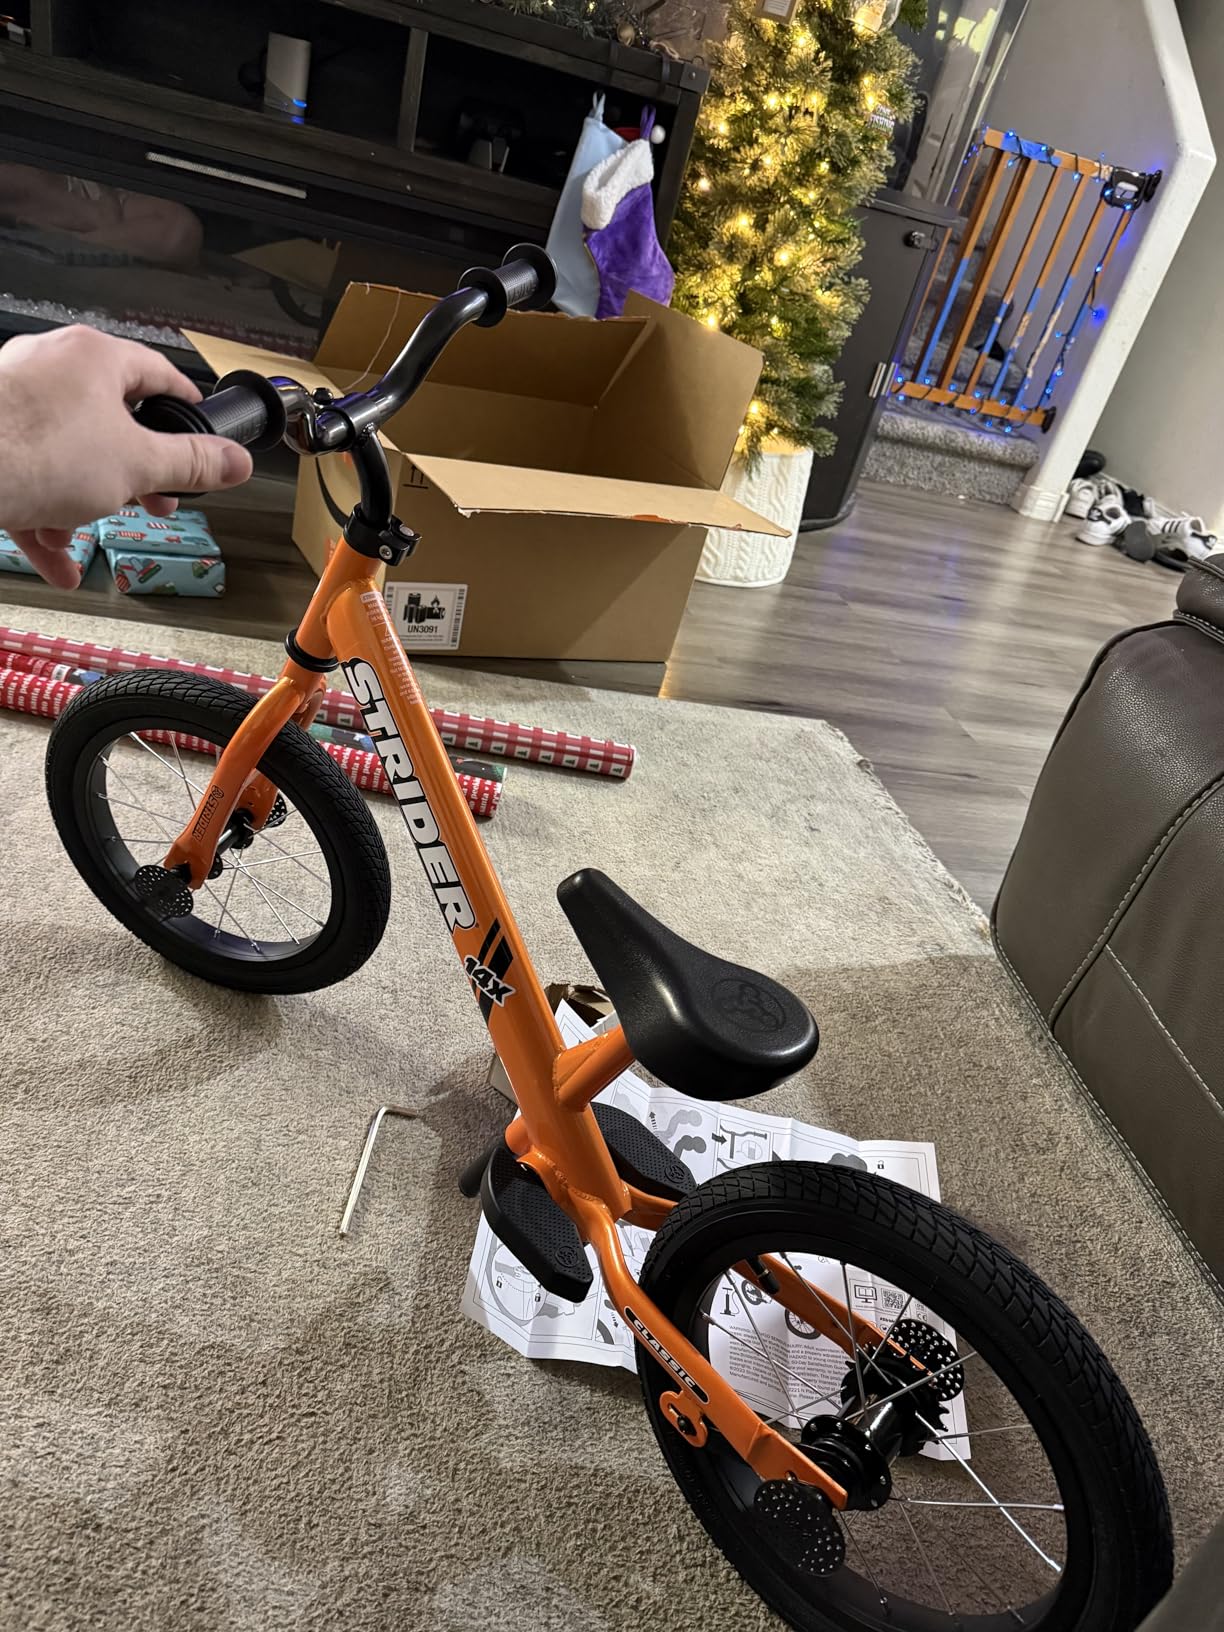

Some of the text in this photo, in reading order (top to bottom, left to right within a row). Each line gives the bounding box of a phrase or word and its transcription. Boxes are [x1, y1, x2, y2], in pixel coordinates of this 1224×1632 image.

[407, 624, 438, 634] UN3091
[192, 794, 218, 841] STRIDER
[346, 658, 477, 932] STRIDER
[464, 956, 515, 1005] 14X
[633, 1318, 696, 1388] CLASSIC
